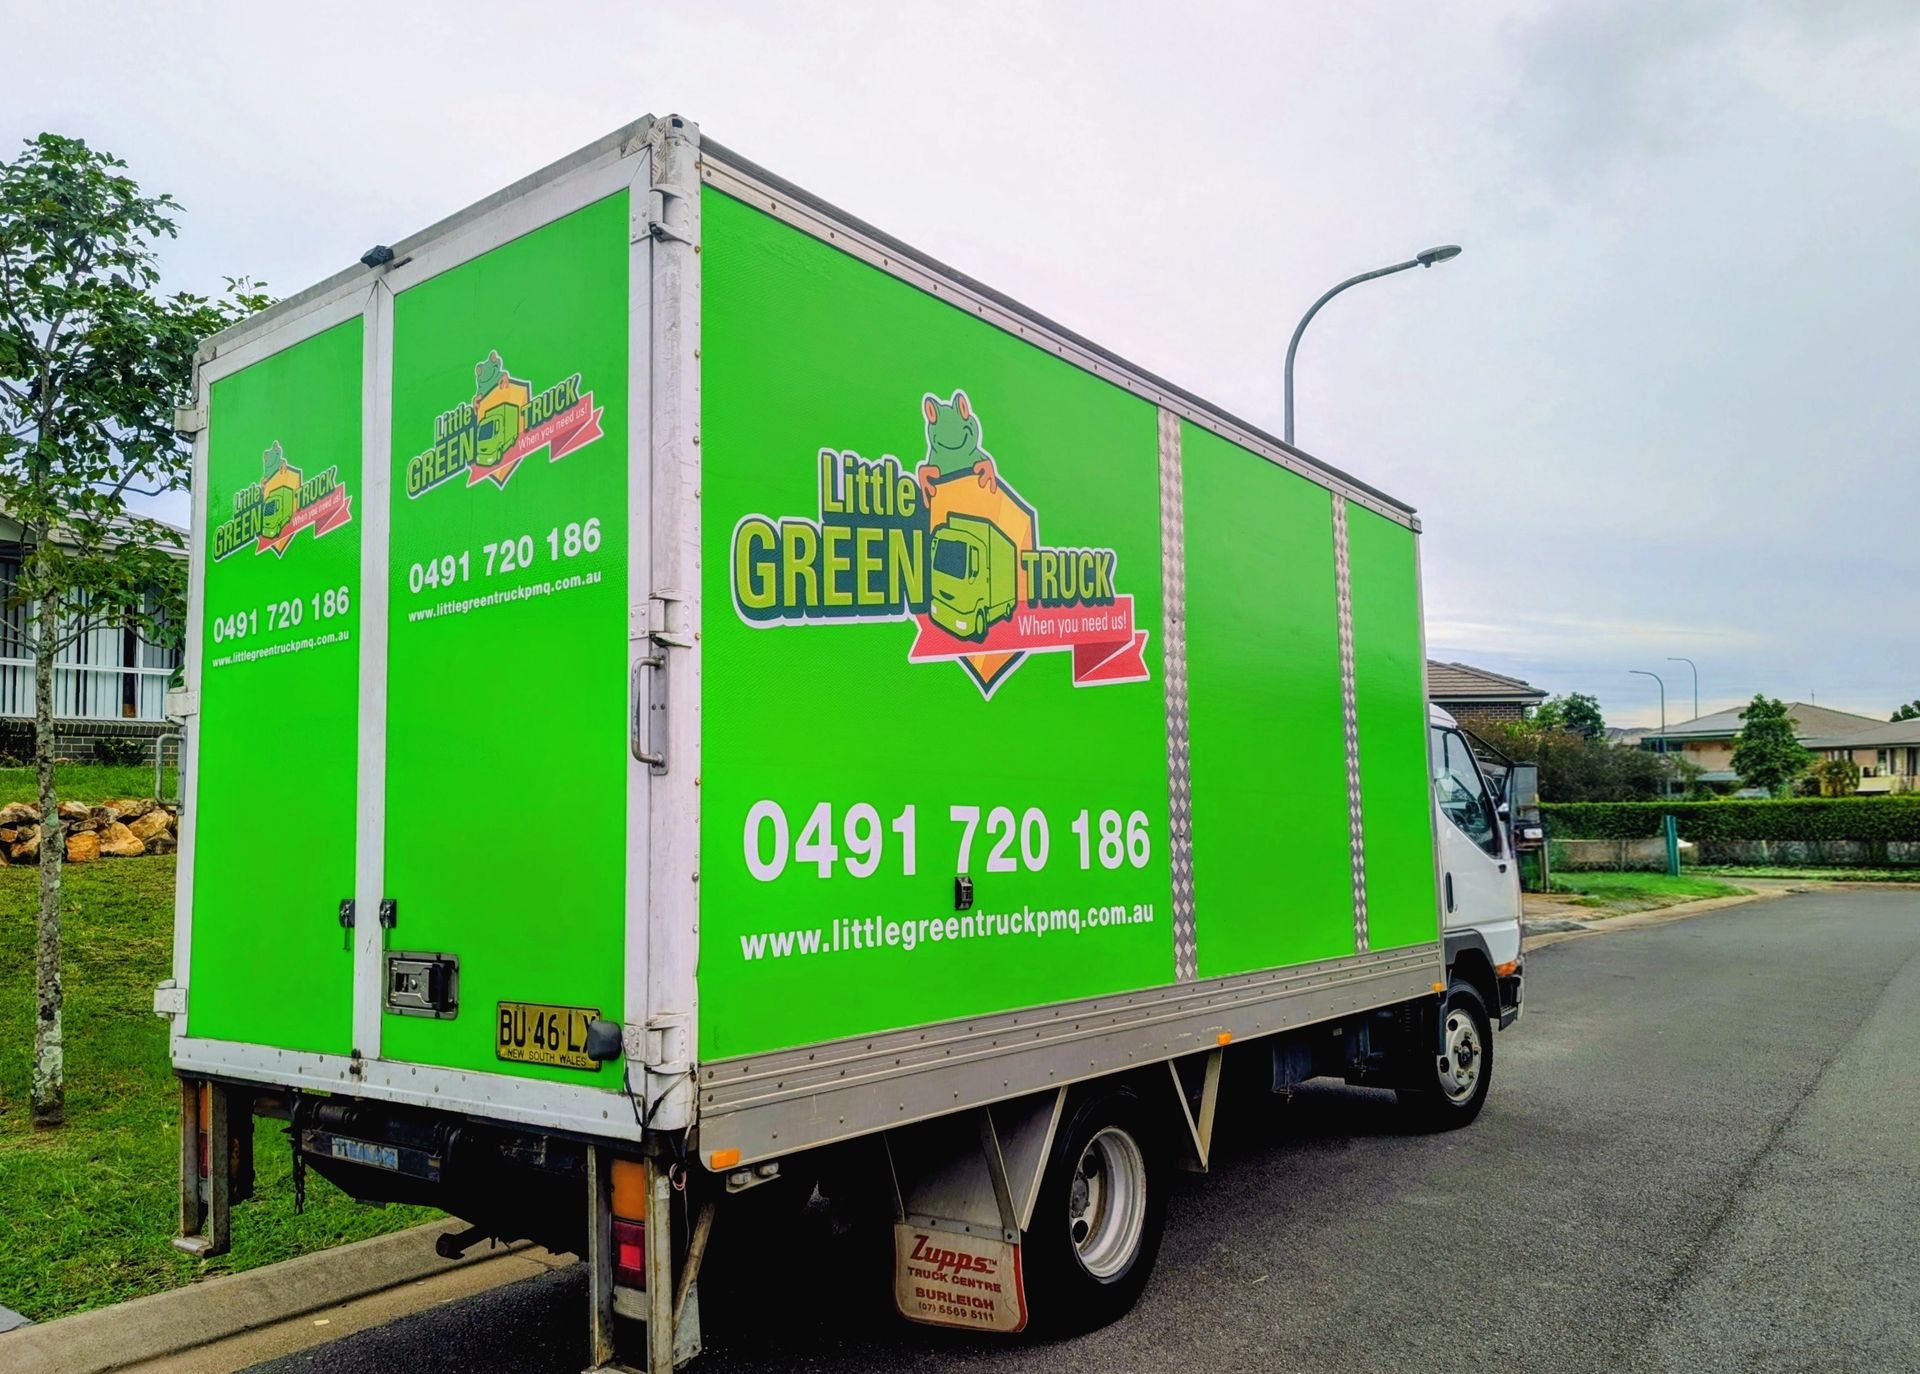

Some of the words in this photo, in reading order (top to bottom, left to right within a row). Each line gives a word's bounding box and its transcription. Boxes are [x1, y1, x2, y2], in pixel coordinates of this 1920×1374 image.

[436, 403, 473, 441] Little
[518, 431, 540, 450] When
[541, 423, 554, 442] you
[556, 410, 575, 430] need
[575, 402, 588, 420] us!
[521, 375, 580, 430] TRUCK
[408, 427, 475, 495] GREEN
[822, 451, 918, 518] Little
[234, 484, 262, 515] Little
[296, 467, 337, 510] TRUCK
[213, 503, 263, 558] GREEN
[408, 550, 470, 594] 0491
[483, 534, 534, 576] 720
[546, 517, 601, 561] 186
[735, 519, 928, 617] GREEN
[1021, 550, 1113, 605] TRUCK
[213, 608, 257, 643] 0491
[266, 597, 303, 631] 720
[311, 585, 350, 620] 186
[408, 571, 601, 622] www.littlegreentruckpmq.com.au
[211, 630, 350, 667] www.littlegreentruckpmq.com.au
[1018, 614, 1055, 636] When
[1058, 618, 1078, 639] you
[1082, 610, 1108, 632] need
[1112, 609, 1127, 630] us!
[743, 800, 917, 882] 0491
[950, 805, 1050, 874] 720
[1071, 809, 1151, 870] 186
[740, 903, 1154, 961] www.littlegreentruckpmq.com.au
[507, 1049, 525, 1060] NEW
[528, 1050, 555, 1062] SOUTH
[560, 1053, 587, 1067] WALES
[910, 1234, 995, 1274] Zupps
[907, 1266, 949, 1284] TRUCK
[951, 1275, 1002, 1293] CENTRE
[915, 1287, 995, 1311] BURLEIGH
[918, 1301, 936, 1313] (07)
